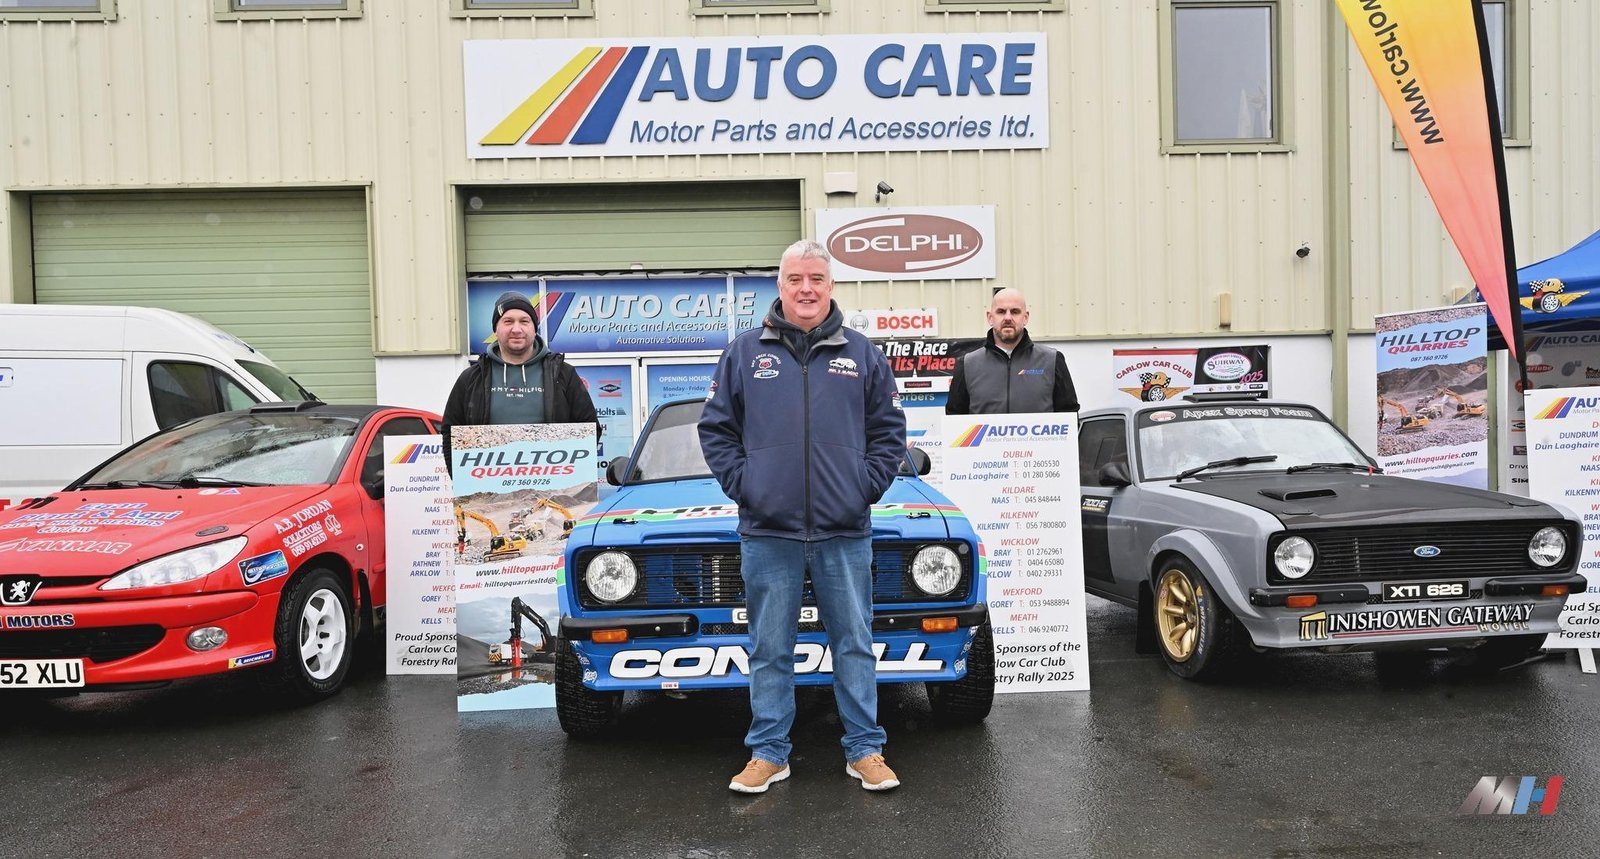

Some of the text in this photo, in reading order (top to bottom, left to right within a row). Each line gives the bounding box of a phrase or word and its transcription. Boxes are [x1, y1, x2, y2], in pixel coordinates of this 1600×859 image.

[637, 42, 1036, 103] AUTO CARE
[629, 113, 1035, 145] Motor Parts and Accessories ltd.
[844, 233, 963, 253] DELPHI
[571, 292, 756, 319] AUTO CARE
[569, 321, 606, 333] Motor
[607, 321, 638, 333] Parts
[640, 320, 664, 332] and
[666, 319, 734, 332] Accessorie
[877, 315, 934, 330] BOSCH
[616, 335, 705, 345] Automotive Solutions
[1380, 327, 1480, 347] HILLTOP
[1544, 336, 1578, 344] AUTO
[885, 341, 948, 357] The Race
[1387, 340, 1469, 354] QUARRIES
[895, 357, 914, 371] Its
[917, 356, 956, 371] Place
[1116, 361, 1151, 379] CARLOW
[1153, 360, 1171, 368] CAR
[1172, 364, 1193, 379] CLUB
[1239, 370, 1264, 384] 2025
[1183, 408, 1224, 420] Apex
[1225, 407, 1269, 418] Spray
[1272, 407, 1313, 418] Foam
[987, 424, 1069, 437] AUTO CARE
[1560, 431, 1598, 439] DUNDRUM
[1555, 441, 1600, 451] Laoghaire
[459, 449, 590, 467] HILLTOP
[973, 461, 1008, 469] DUNDRUM
[471, 465, 575, 478] QUARRIES
[950, 473, 967, 481] Dun
[969, 473, 1009, 481] Laoghaire
[405, 485, 440, 493] Laoghaire
[1002, 486, 1035, 494] KILDARE
[89, 510, 115, 518] &
[115, 510, 184, 520] Agri
[274, 499, 333, 534] A.B. JORDAN
[1000, 511, 1039, 519] KILKENNY
[977, 522, 1010, 530] KILKENNY
[282, 521, 323, 547] SOLICITORS
[16, 540, 133, 555] YANMAR
[1000, 538, 1040, 546] WICKLOW
[994, 549, 1011, 557] BRAY
[1420, 546, 1435, 555] Ford
[1045, 558, 1064, 566] 65080
[1003, 588, 1042, 596] WEXFORD
[1427, 584, 1463, 596] 626
[990, 600, 1013, 608] GOREY
[7, 614, 75, 628] MOTORS
[1329, 604, 1535, 632] INISHOWEN GATEWAY
[1043, 625, 1069, 633] 9240772
[1480, 622, 1530, 632] HOTEL
[395, 633, 423, 641] Proud
[408, 645, 441, 653] Carlow
[996, 642, 1081, 655] Sponsors of the
[401, 658, 440, 667] Forestry
[1019, 657, 1066, 667] Car Club
[0, 663, 81, 684] 52 XLU
[1017, 673, 1045, 684] Rally
[1047, 671, 1075, 681] 2025
